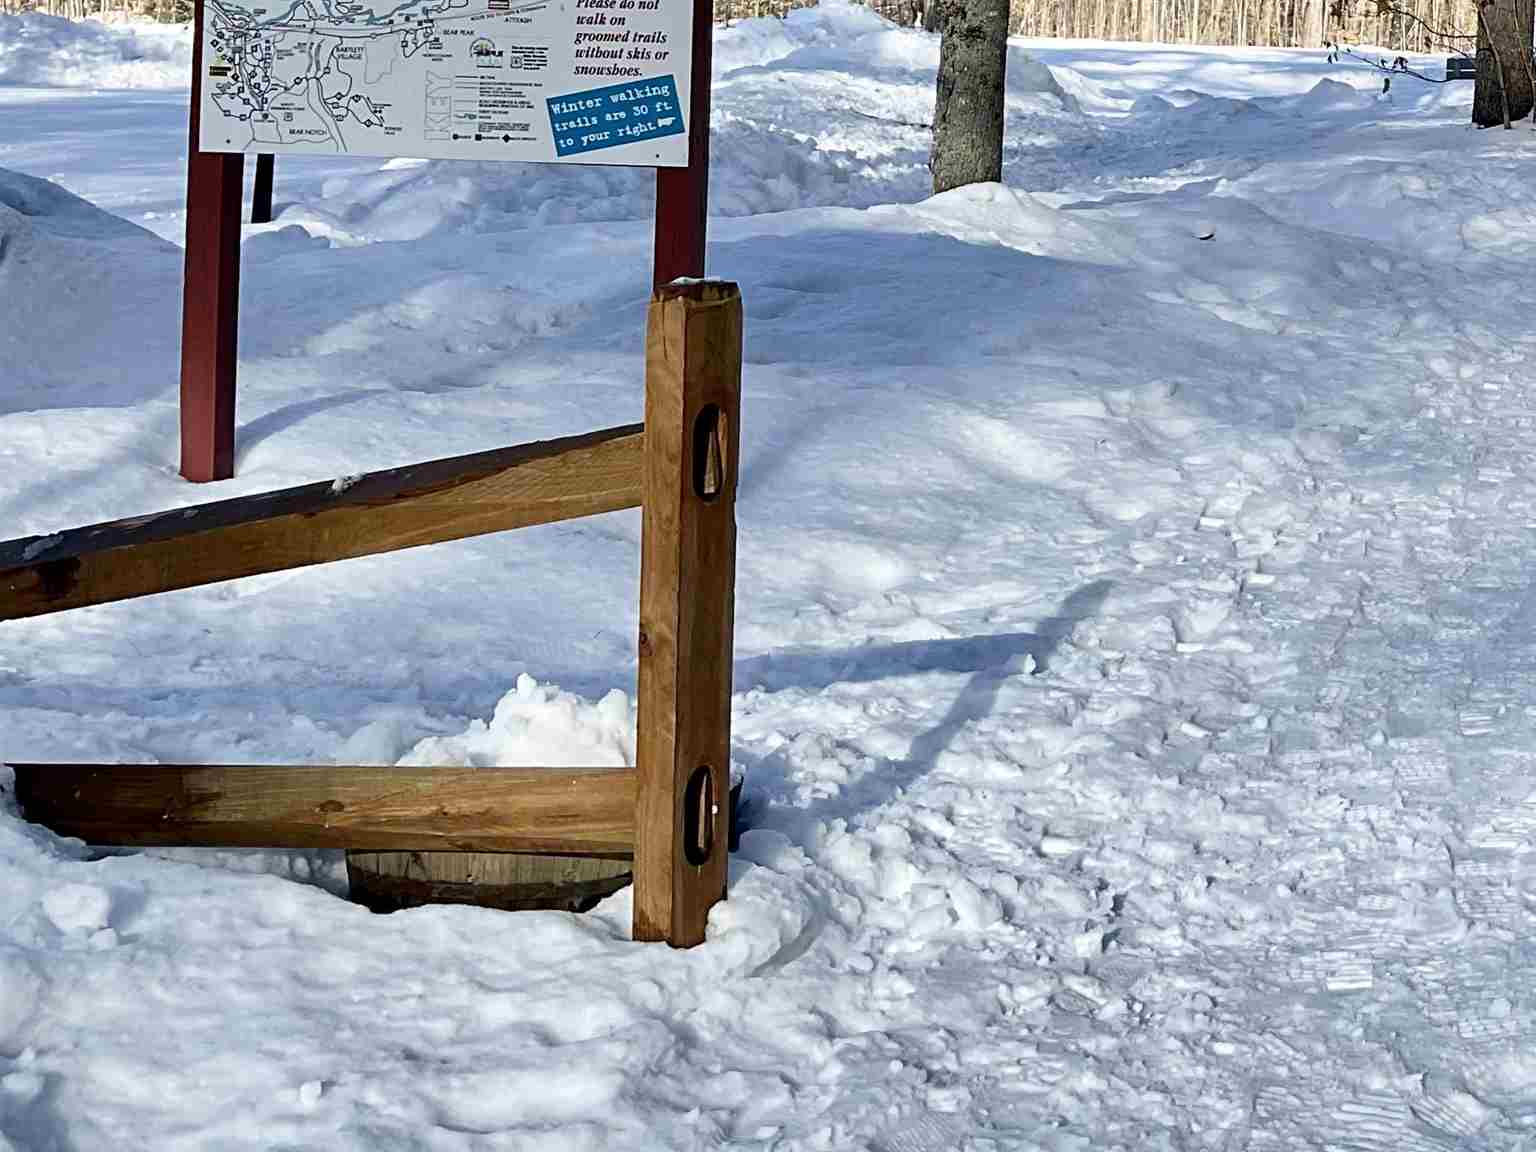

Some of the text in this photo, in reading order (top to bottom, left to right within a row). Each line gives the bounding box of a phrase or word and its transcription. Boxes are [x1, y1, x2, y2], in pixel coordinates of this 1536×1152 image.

[576, 12, 626, 26] walk on
[574, 31, 668, 45] groomed trails
[575, 47, 670, 61] without skis or
[574, 63, 644, 77] snowshoes.
[551, 97, 603, 115] Winter
[609, 84, 671, 104] walking
[554, 115, 599, 132] trails
[605, 110, 627, 122] are
[632, 104, 649, 116] 30
[559, 136, 574, 148] to
[581, 130, 611, 146] your
